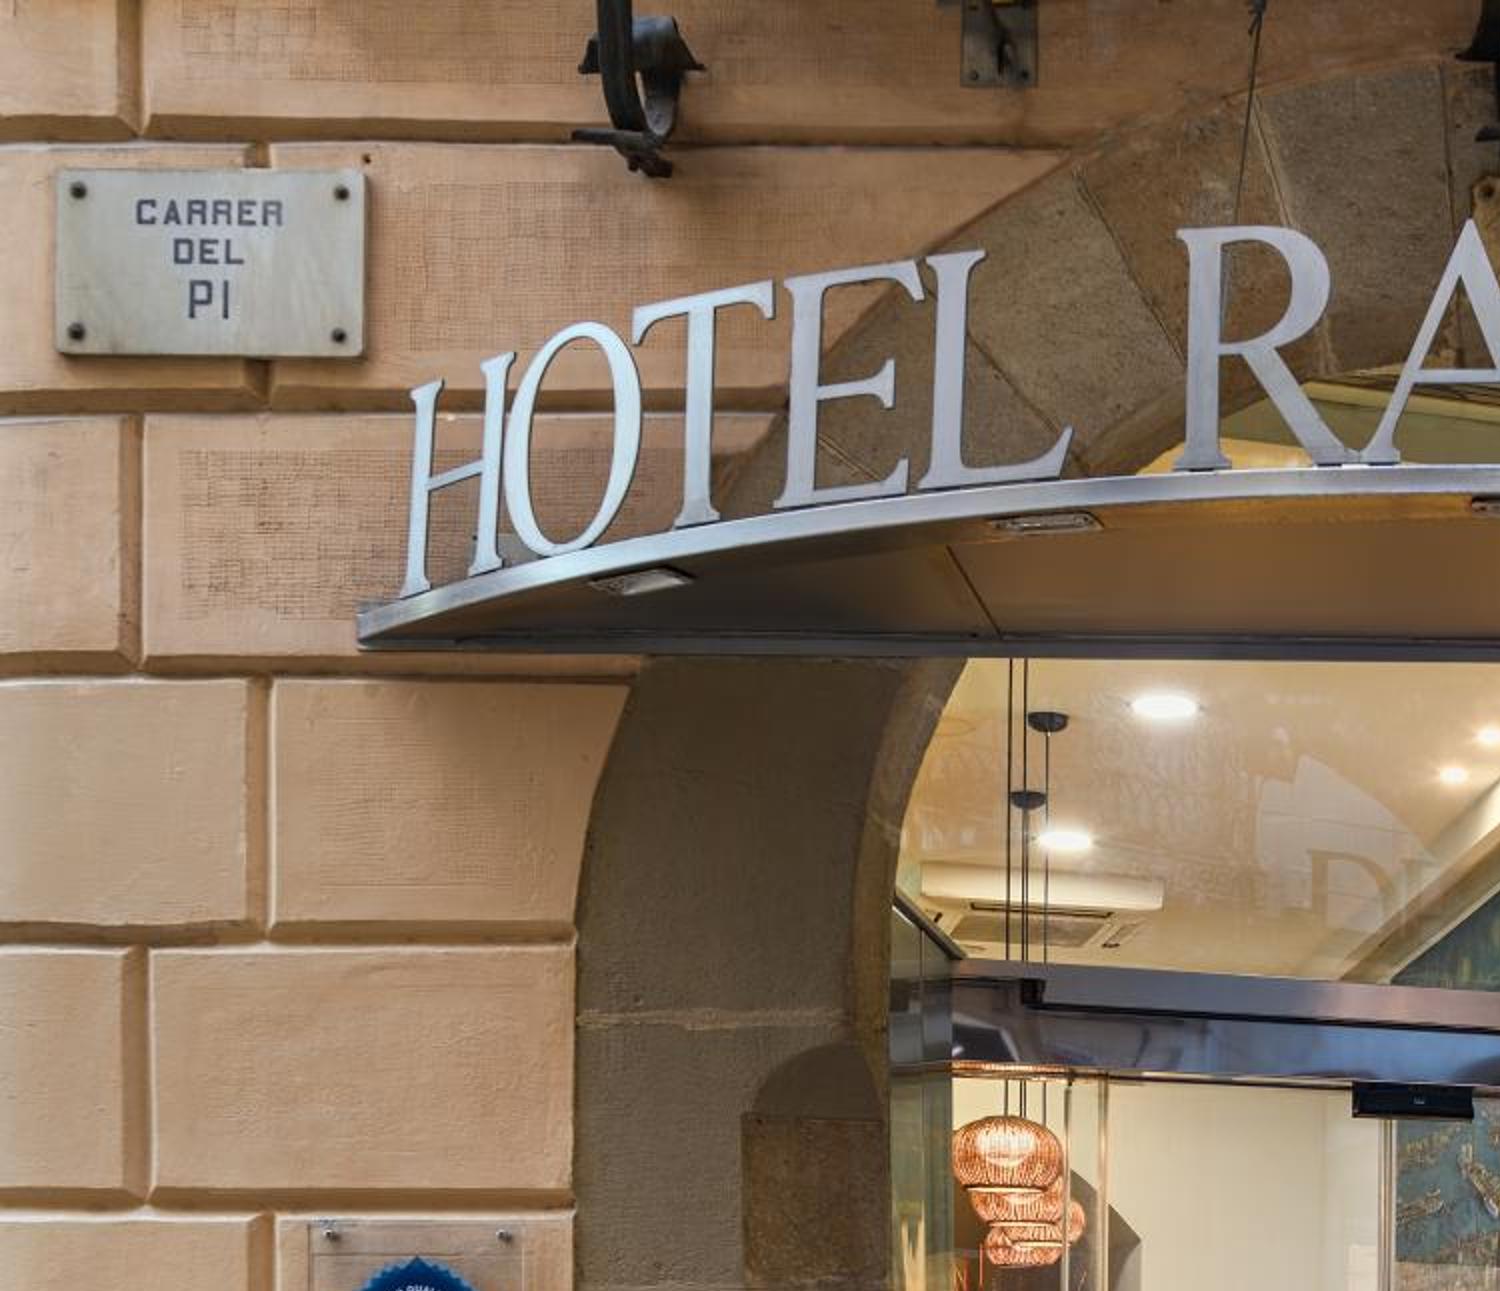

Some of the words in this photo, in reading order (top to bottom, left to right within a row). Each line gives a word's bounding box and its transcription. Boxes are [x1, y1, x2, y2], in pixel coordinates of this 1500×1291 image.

[136, 199, 283, 227] CARRER
[173, 239, 244, 265] DEL
[188, 280, 230, 319] PI
[400, 249, 1075, 599] HOTEL
